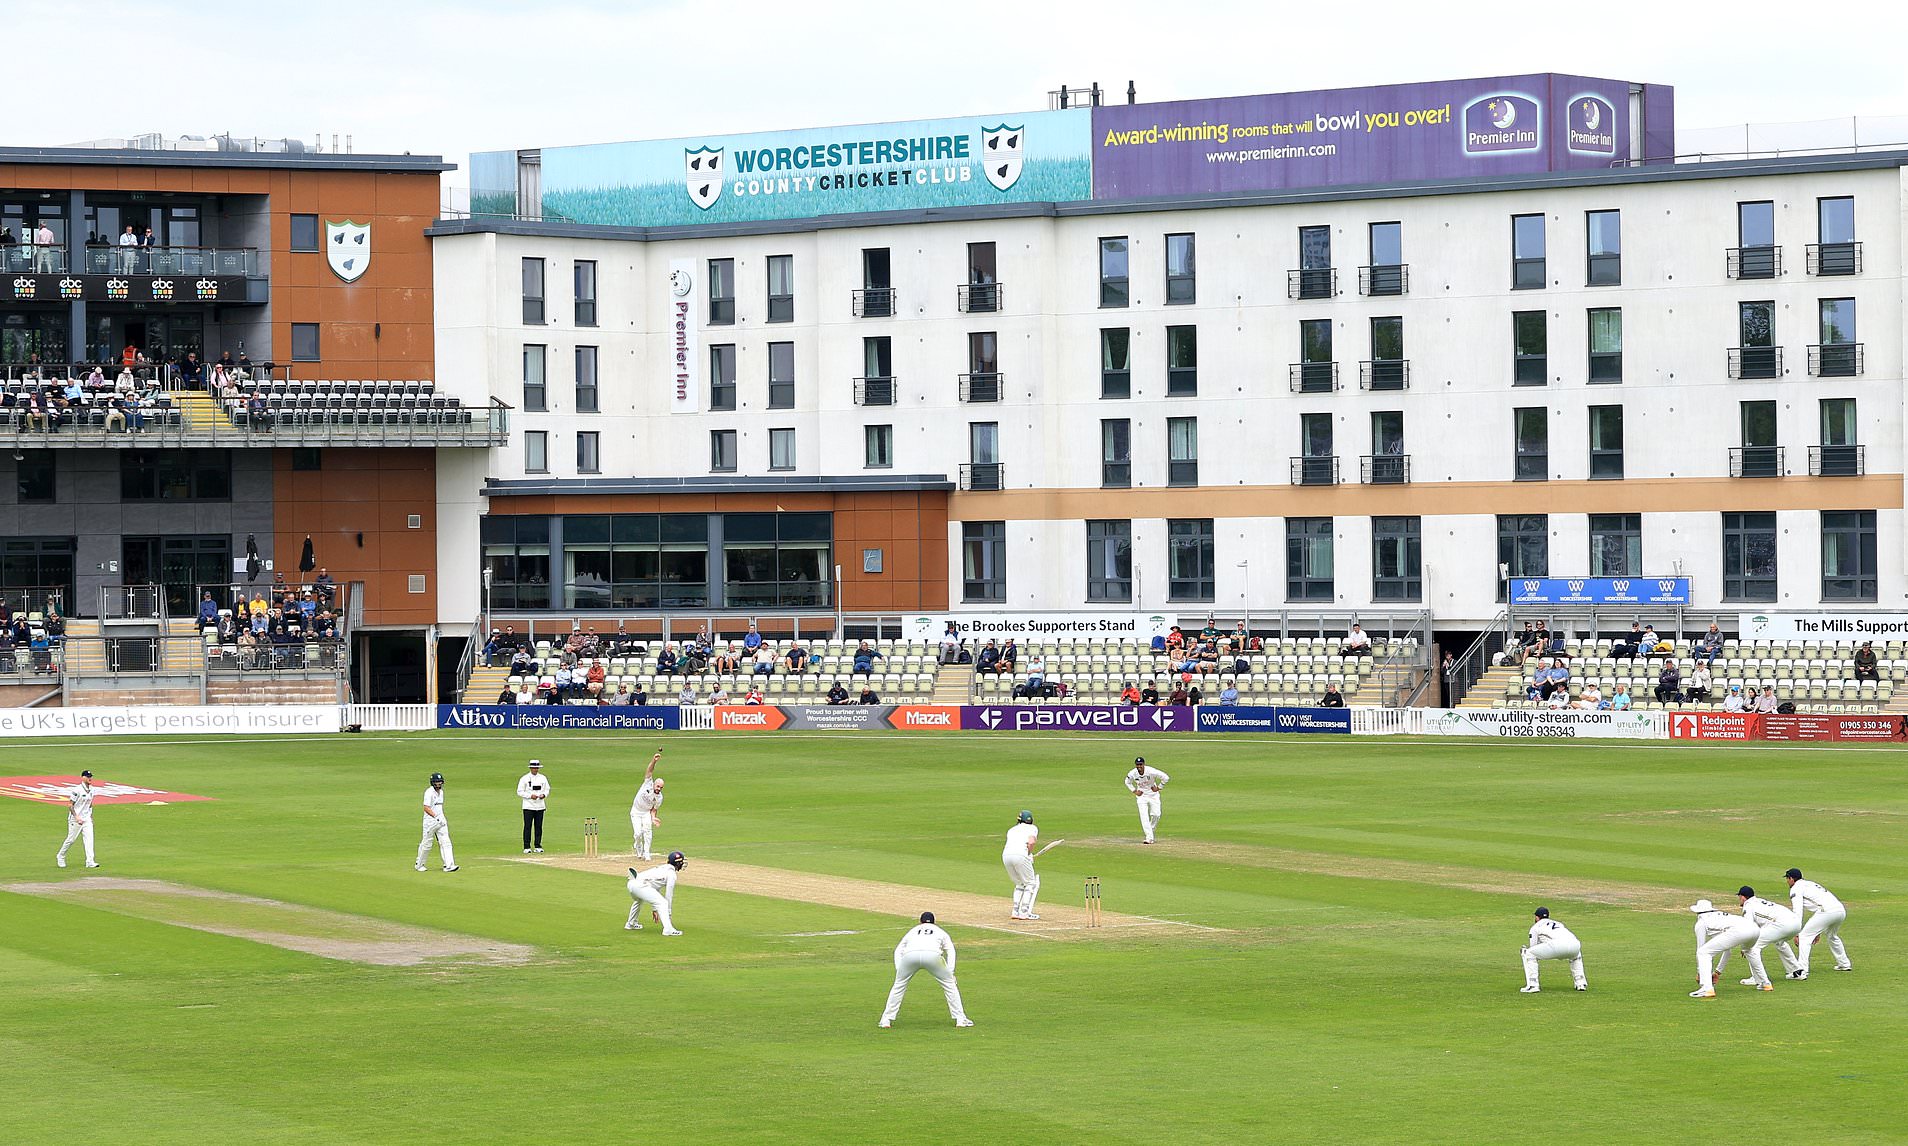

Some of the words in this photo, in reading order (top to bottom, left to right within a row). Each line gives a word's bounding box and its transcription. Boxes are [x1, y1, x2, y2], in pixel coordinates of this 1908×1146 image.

[1104, 121, 1229, 147] Award-winning
[1232, 125, 1269, 138] rooms
[1271, 121, 1293, 136] that
[1295, 120, 1313, 134] will
[1316, 110, 1360, 132] bowl
[1365, 112, 1400, 132] you
[1404, 104, 1451, 127] over!
[1469, 130, 1515, 145] Premier
[1516, 129, 1535, 142] Inn
[1571, 129, 1599, 144] Premier
[1600, 132, 1612, 146] Inn
[735, 135, 970, 174] WORCESTERSHIRE
[1206, 142, 1336, 164] www.premierinn.com
[734, 176, 816, 197] COUNTY
[820, 170, 912, 191] CRICKET
[915, 166, 972, 185] CLUB
[13, 276, 36, 288] ebc
[59, 276, 82, 288] ebc
[106, 277, 129, 289] ebc
[152, 277, 174, 289] ebc
[196, 277, 218, 289] ebc
[676, 302, 690, 370] Premier
[677, 373, 690, 401] Inn
[972, 620, 1026, 632] Brookes
[1028, 620, 1097, 635] Supporters
[1099, 619, 1135, 631] Stand
[1794, 619, 1818, 631] The
[1821, 619, 1854, 632] Mills
[72, 711, 147, 733] largest
[154, 711, 240, 732] pension
[248, 711, 323, 728] insurer
[444, 706, 506, 726] Attivo
[511, 714, 559, 729] Lifestyle
[562, 714, 612, 727] Financial
[614, 714, 664, 729] Planning
[722, 711, 767, 725] Mazak
[905, 711, 951, 725] Mazak
[1016, 707, 1138, 731] parweld
[1468, 711, 1612, 726] www.utility-stream.com
[1701, 716, 1745, 726] Redpoint
[1840, 721, 1860, 729] 01905
[1863, 721, 1876, 729] 350
[1878, 721, 1892, 729] 346
[1499, 725, 1533, 737] 01926
[1536, 726, 1575, 737] 935343
